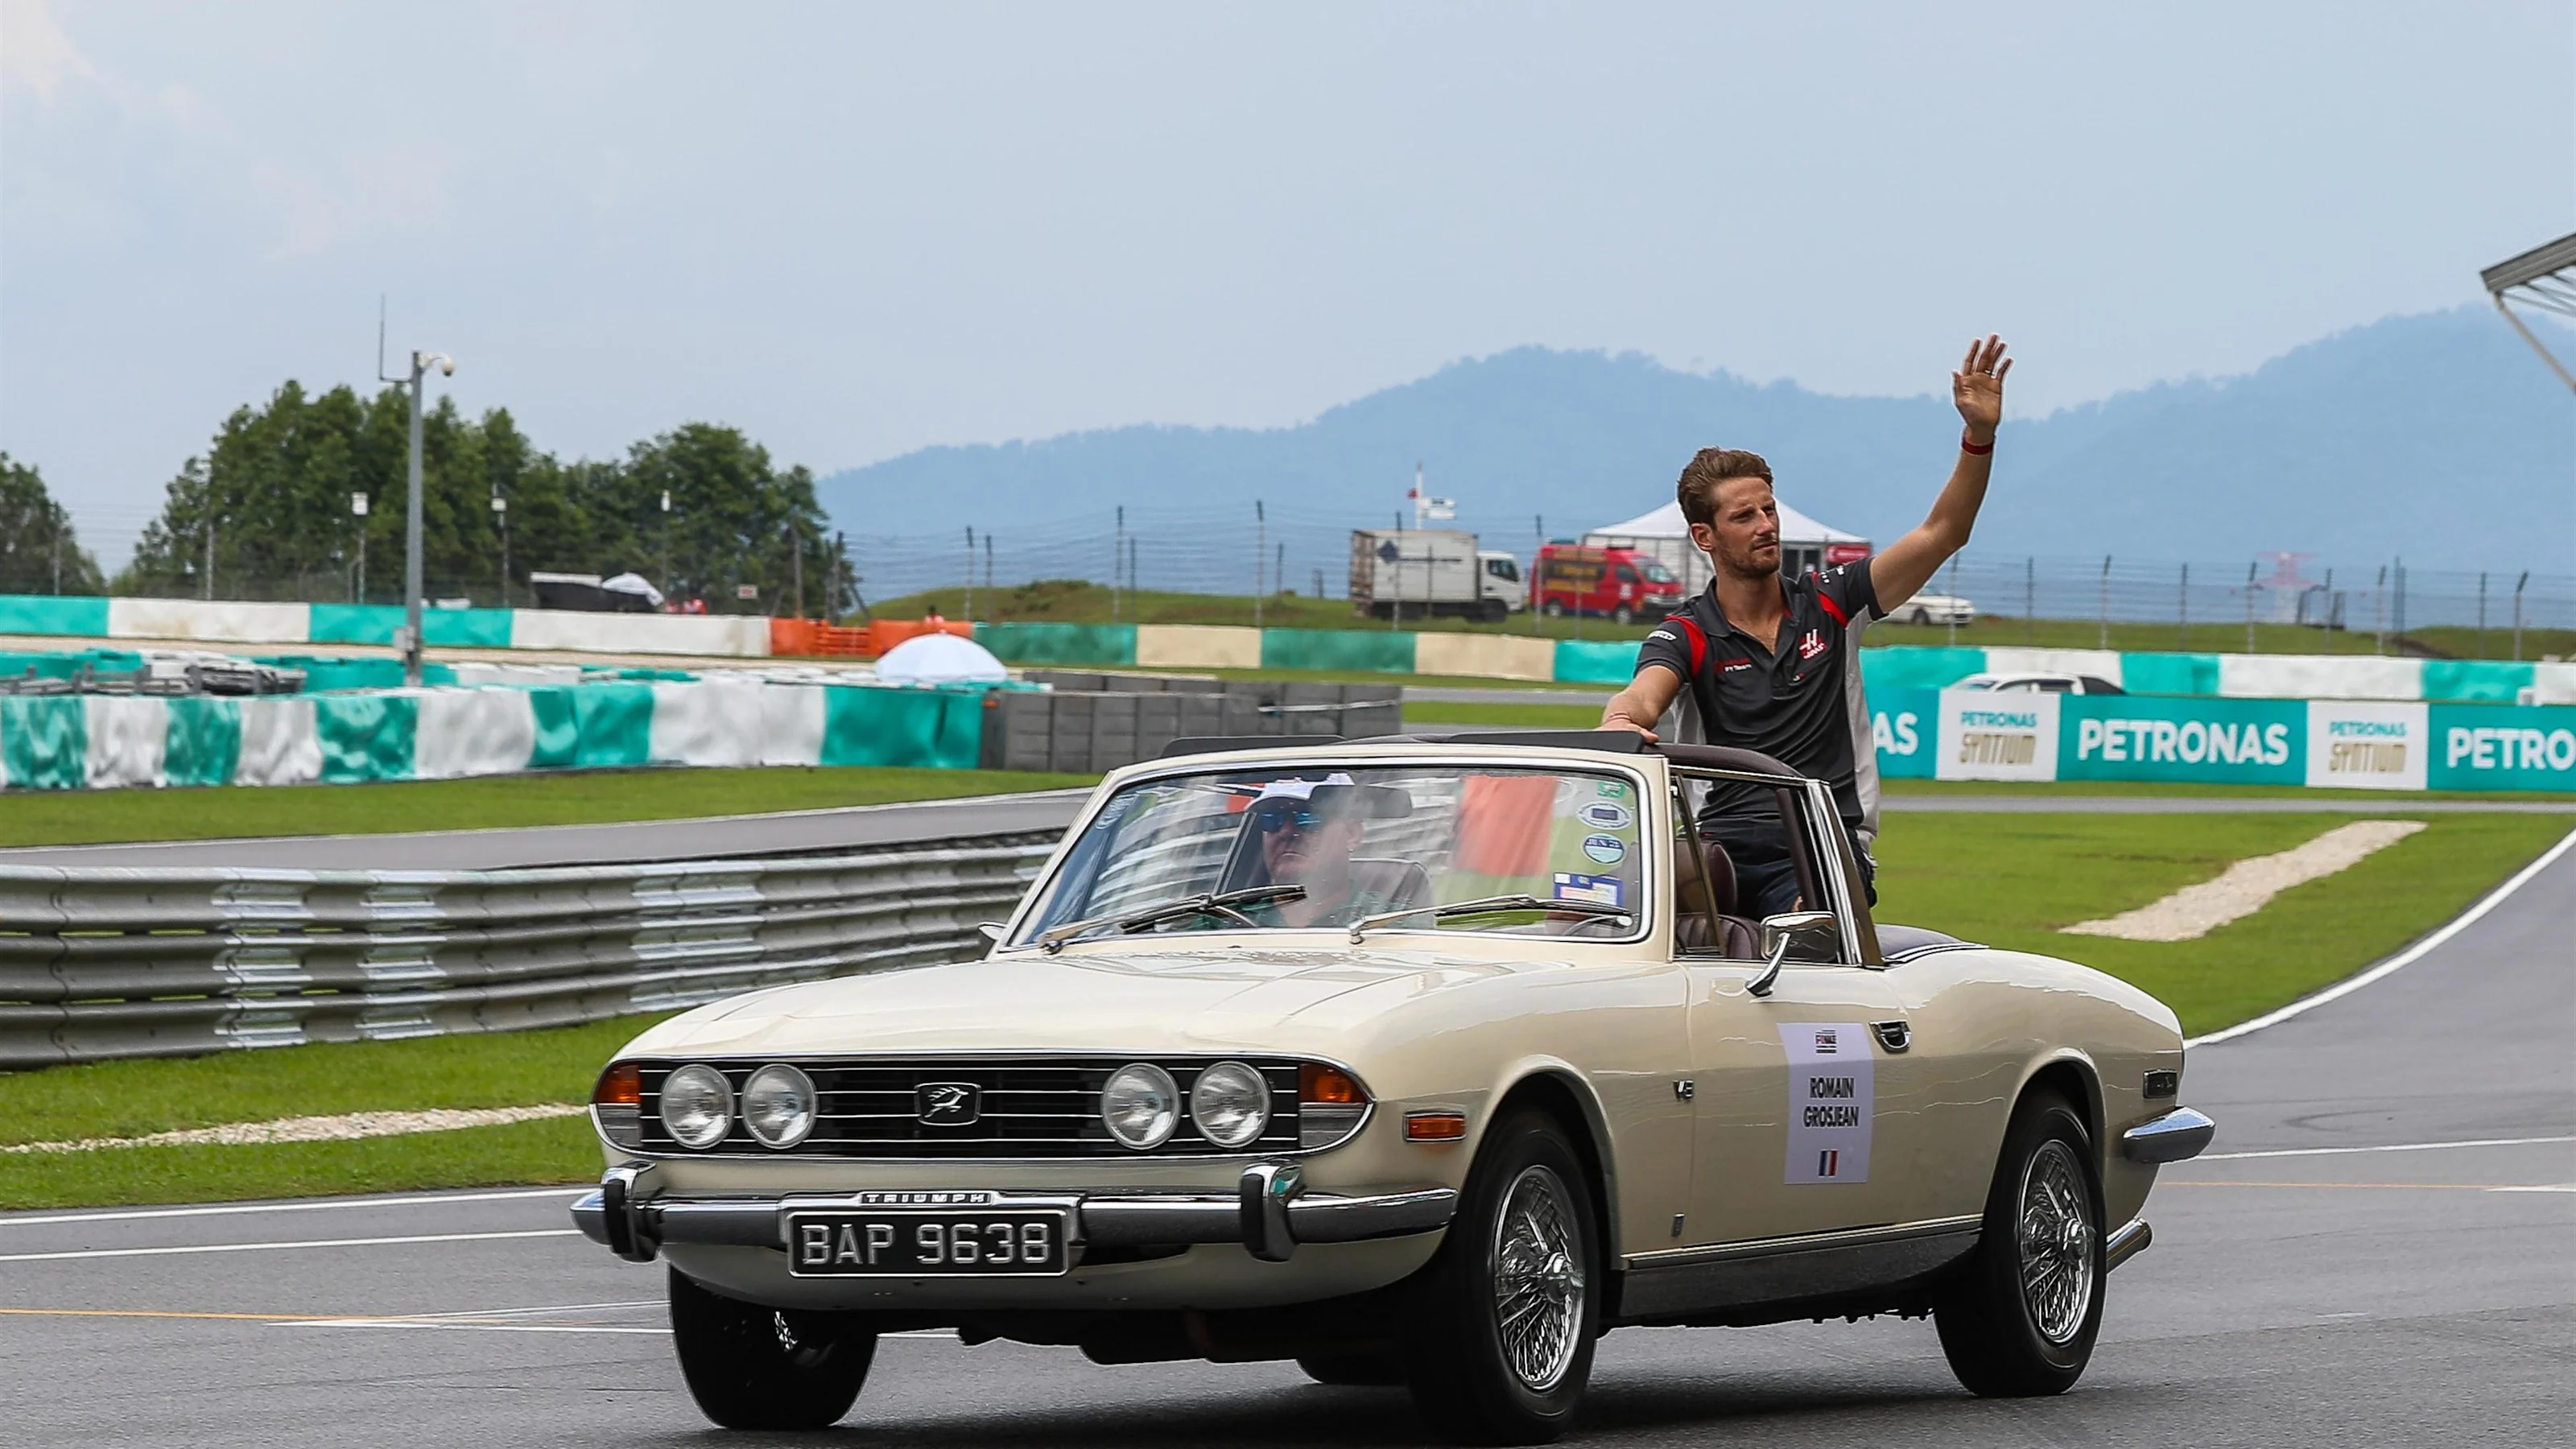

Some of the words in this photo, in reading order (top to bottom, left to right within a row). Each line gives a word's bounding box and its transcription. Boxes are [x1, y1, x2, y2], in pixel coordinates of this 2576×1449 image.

[1960, 711, 2037, 727] PETRONAS
[2329, 721, 2407, 737] PETRONAS
[2078, 718, 2289, 766] PETRONAS
[1809, 1077, 1855, 1099] ROMAIN
[1802, 1105, 1860, 1127] GROSJEAN
[865, 1193, 985, 1204] TRIUMPH
[801, 1223, 895, 1265] BAP
[915, 1222, 1051, 1264] 9638
